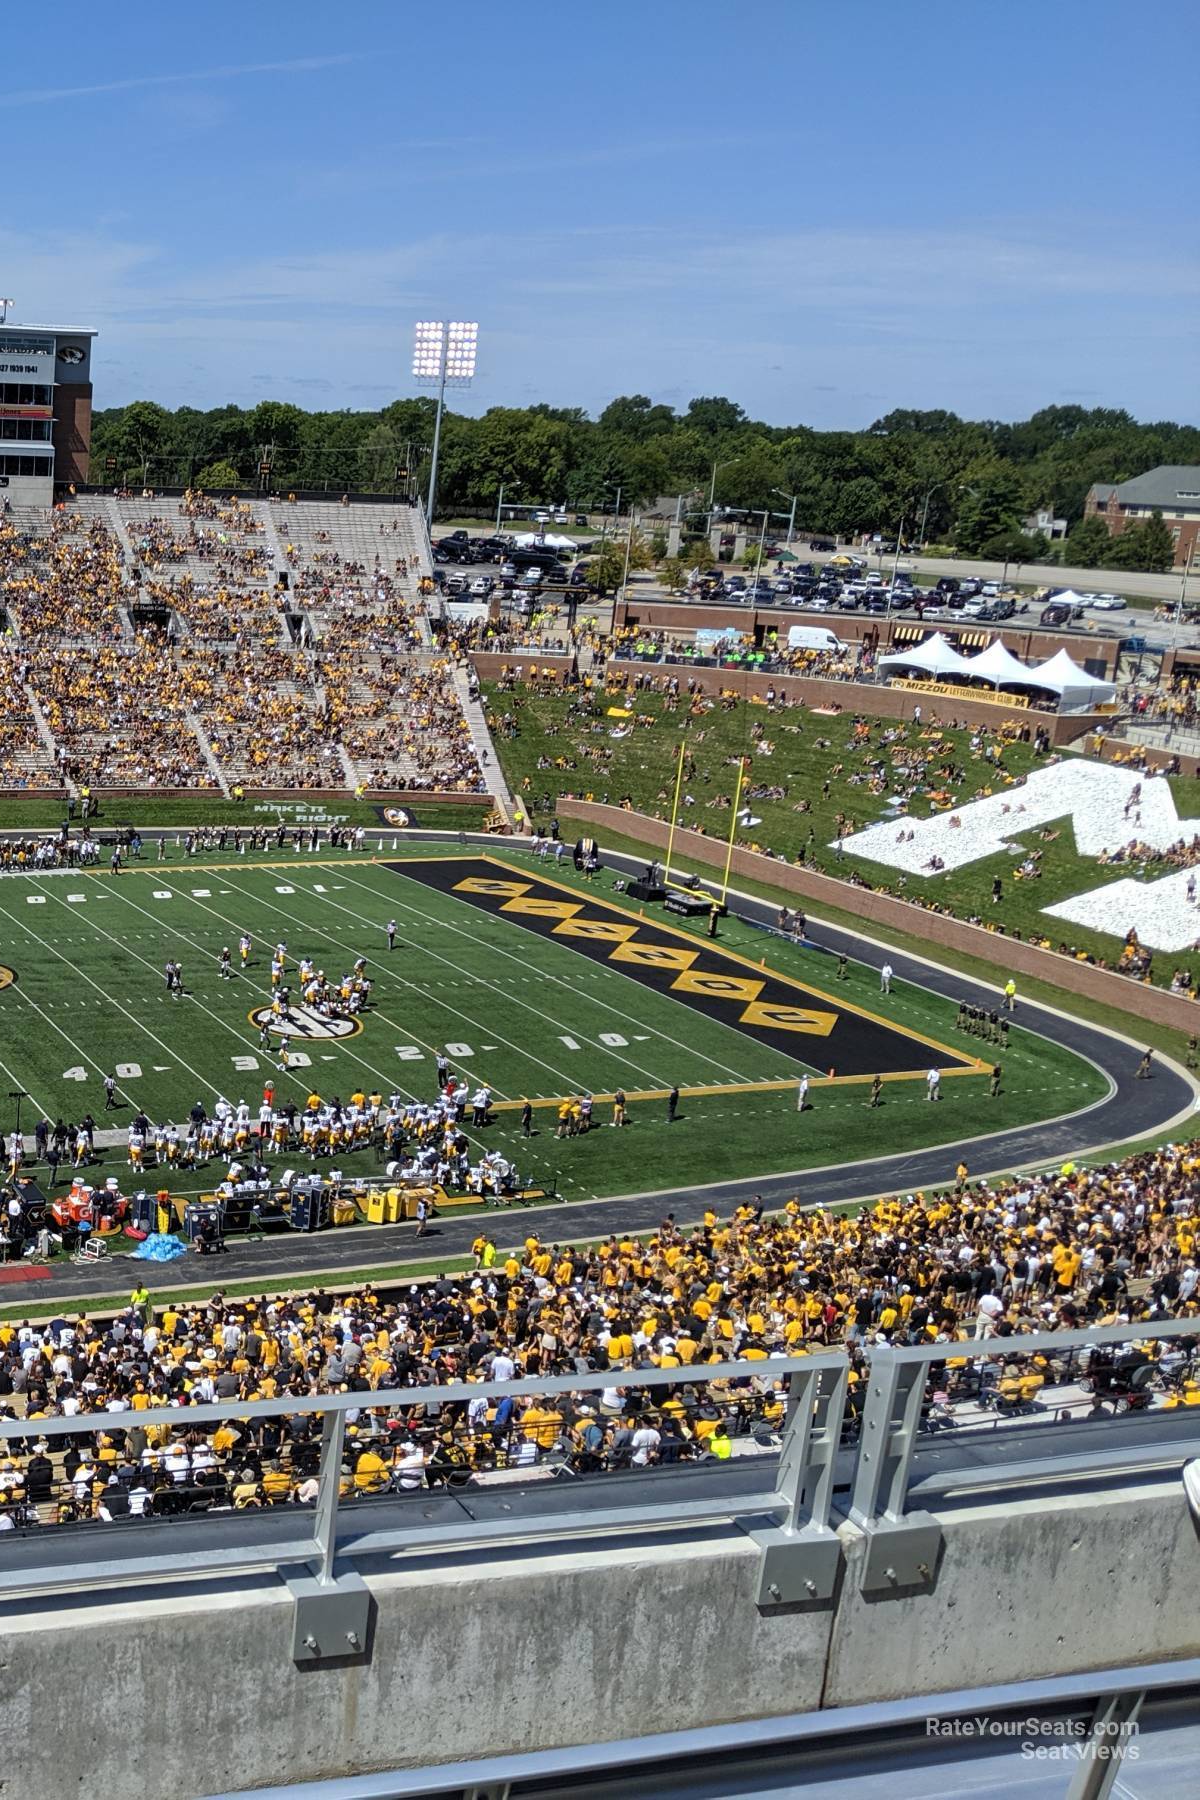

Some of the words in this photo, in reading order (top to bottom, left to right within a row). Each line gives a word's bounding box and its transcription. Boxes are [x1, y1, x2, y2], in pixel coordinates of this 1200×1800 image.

[905, 681, 949, 694] MIZZOU
[997, 693, 1013, 705] CLUB
[254, 804, 307, 813] MAKE
[295, 814, 350, 823] RIGHT
